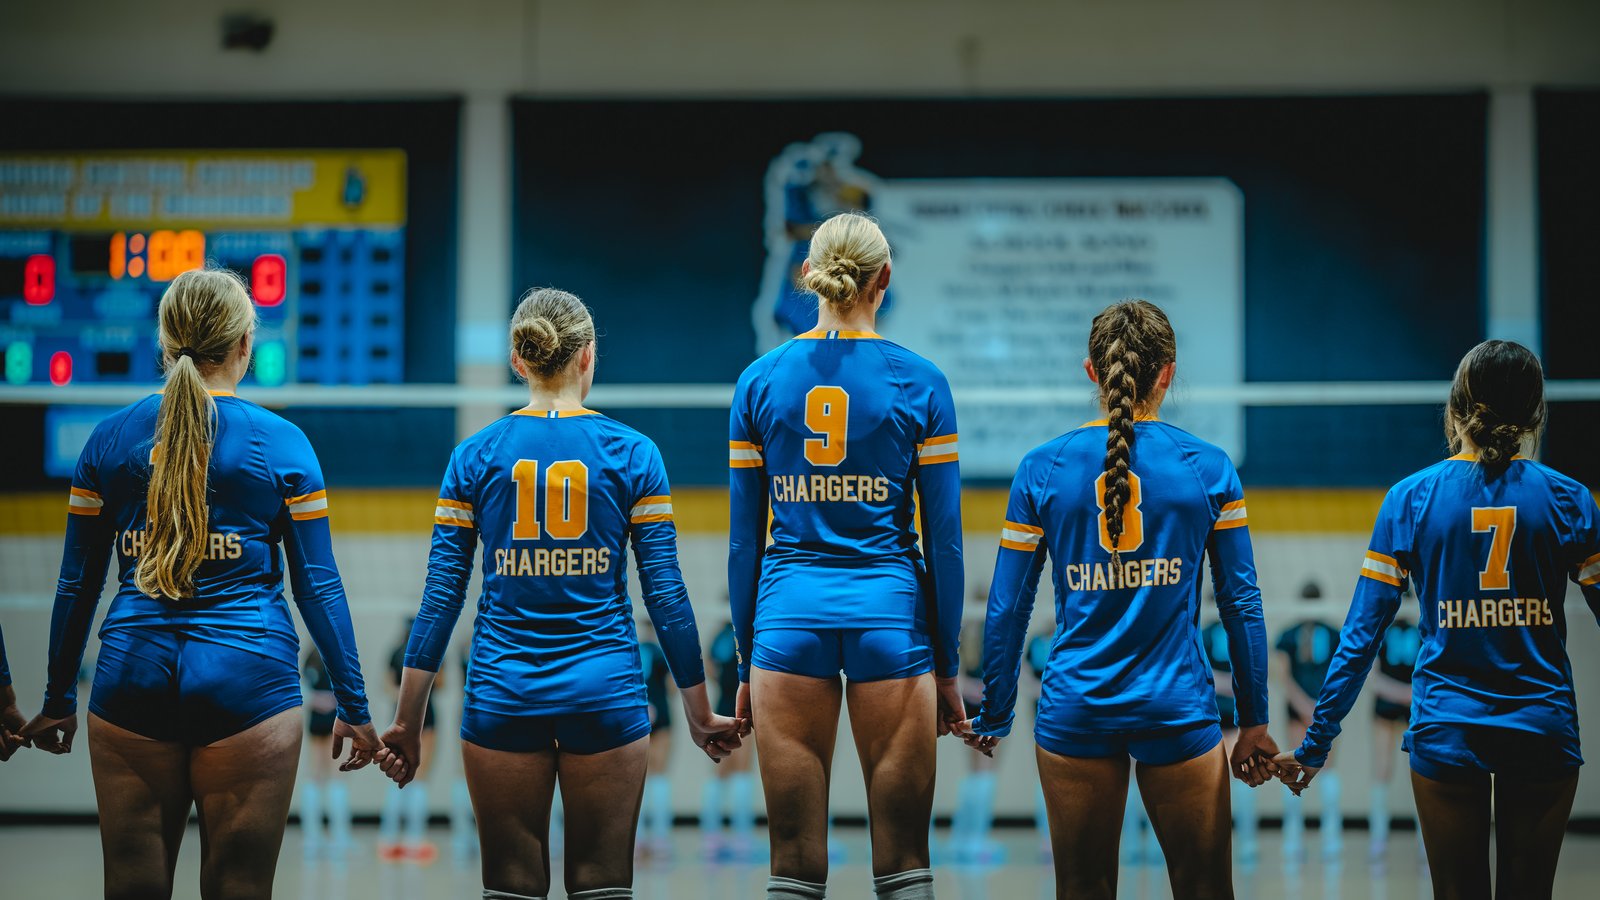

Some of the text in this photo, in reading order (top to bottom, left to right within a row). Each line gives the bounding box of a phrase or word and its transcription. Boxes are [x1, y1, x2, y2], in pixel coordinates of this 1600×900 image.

[24, 254, 56, 305] 0
[109, 230, 206, 282] 1:00
[251, 254, 287, 307] 0
[804, 385, 849, 466] 9
[511, 458, 588, 540] 10
[773, 474, 889, 503] CHARGERS
[1094, 468, 1144, 553] 8
[494, 546, 611, 577] CHARGERS
[1471, 505, 1517, 591] 7
[1437, 598, 1554, 629] CHARGERS
